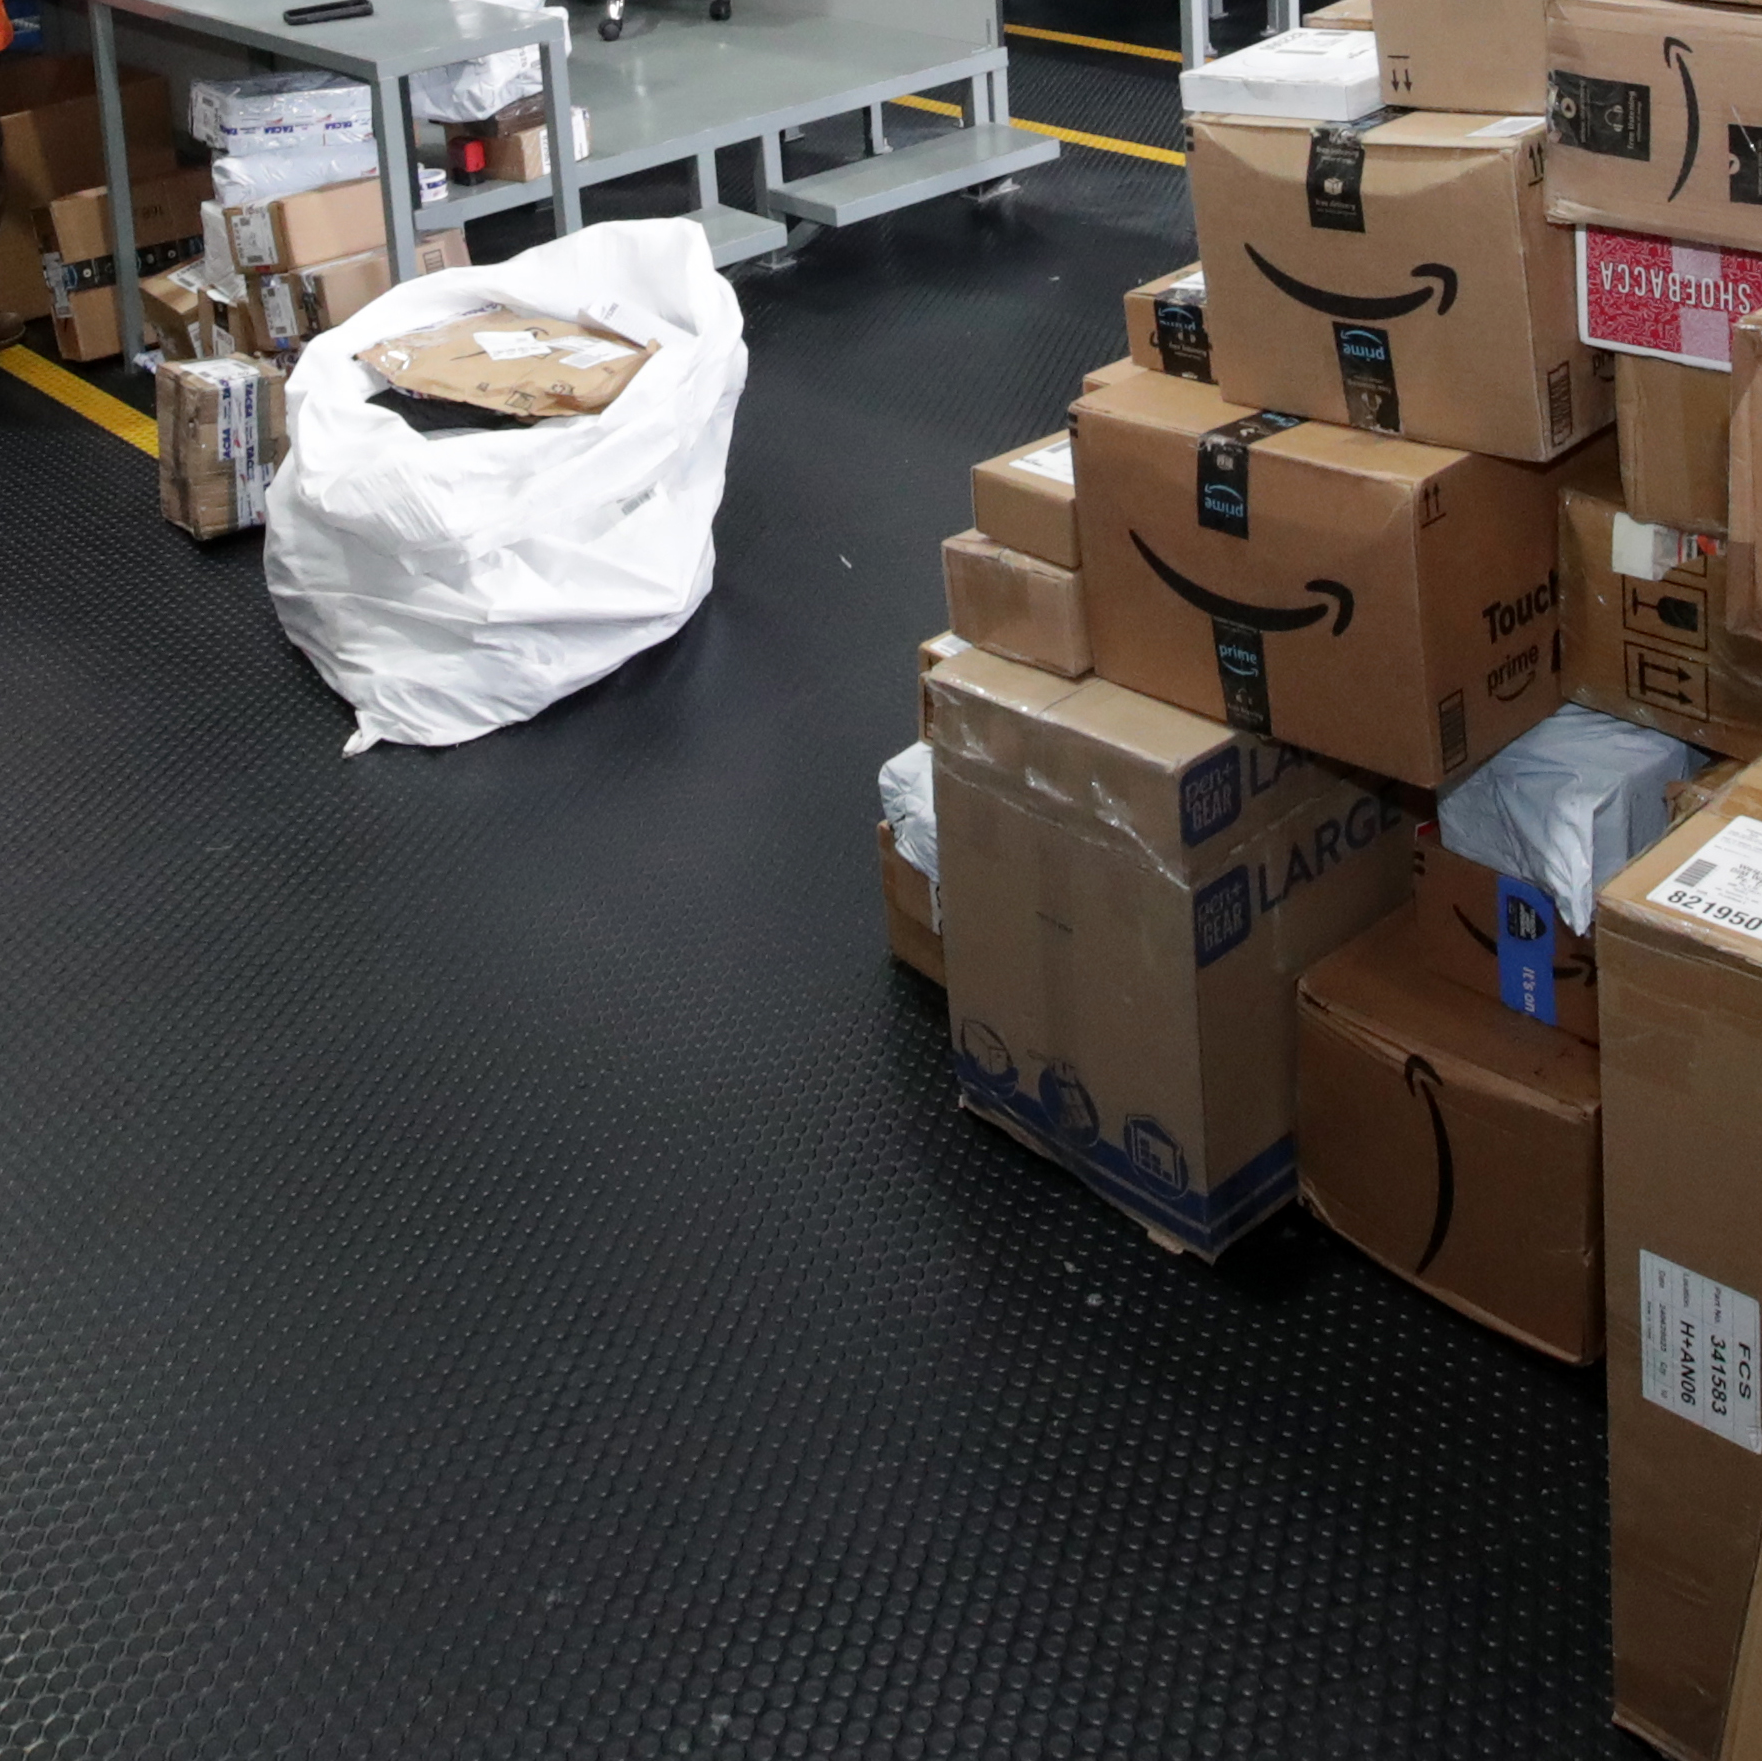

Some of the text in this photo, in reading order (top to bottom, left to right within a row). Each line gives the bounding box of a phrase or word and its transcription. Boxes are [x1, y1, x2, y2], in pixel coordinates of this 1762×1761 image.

[1600, 261, 1751, 314] SHOEBACCA
[1343, 342, 1385, 360] prime
[1205, 496, 1244, 518] prime
[1219, 644, 1258, 666] prime
[1487, 644, 1538, 697] prime
[1192, 783, 1232, 828] GEAR
[1257, 795, 1403, 914] LARGE
[1729, 866, 1748, 877] DIM
[1203, 898, 1242, 952] GEAR
[1680, 1320, 1696, 1407] H+AN06
[1711, 1286, 1727, 1417] Part No. 341583
[1739, 1342, 1752, 1400] FCS
